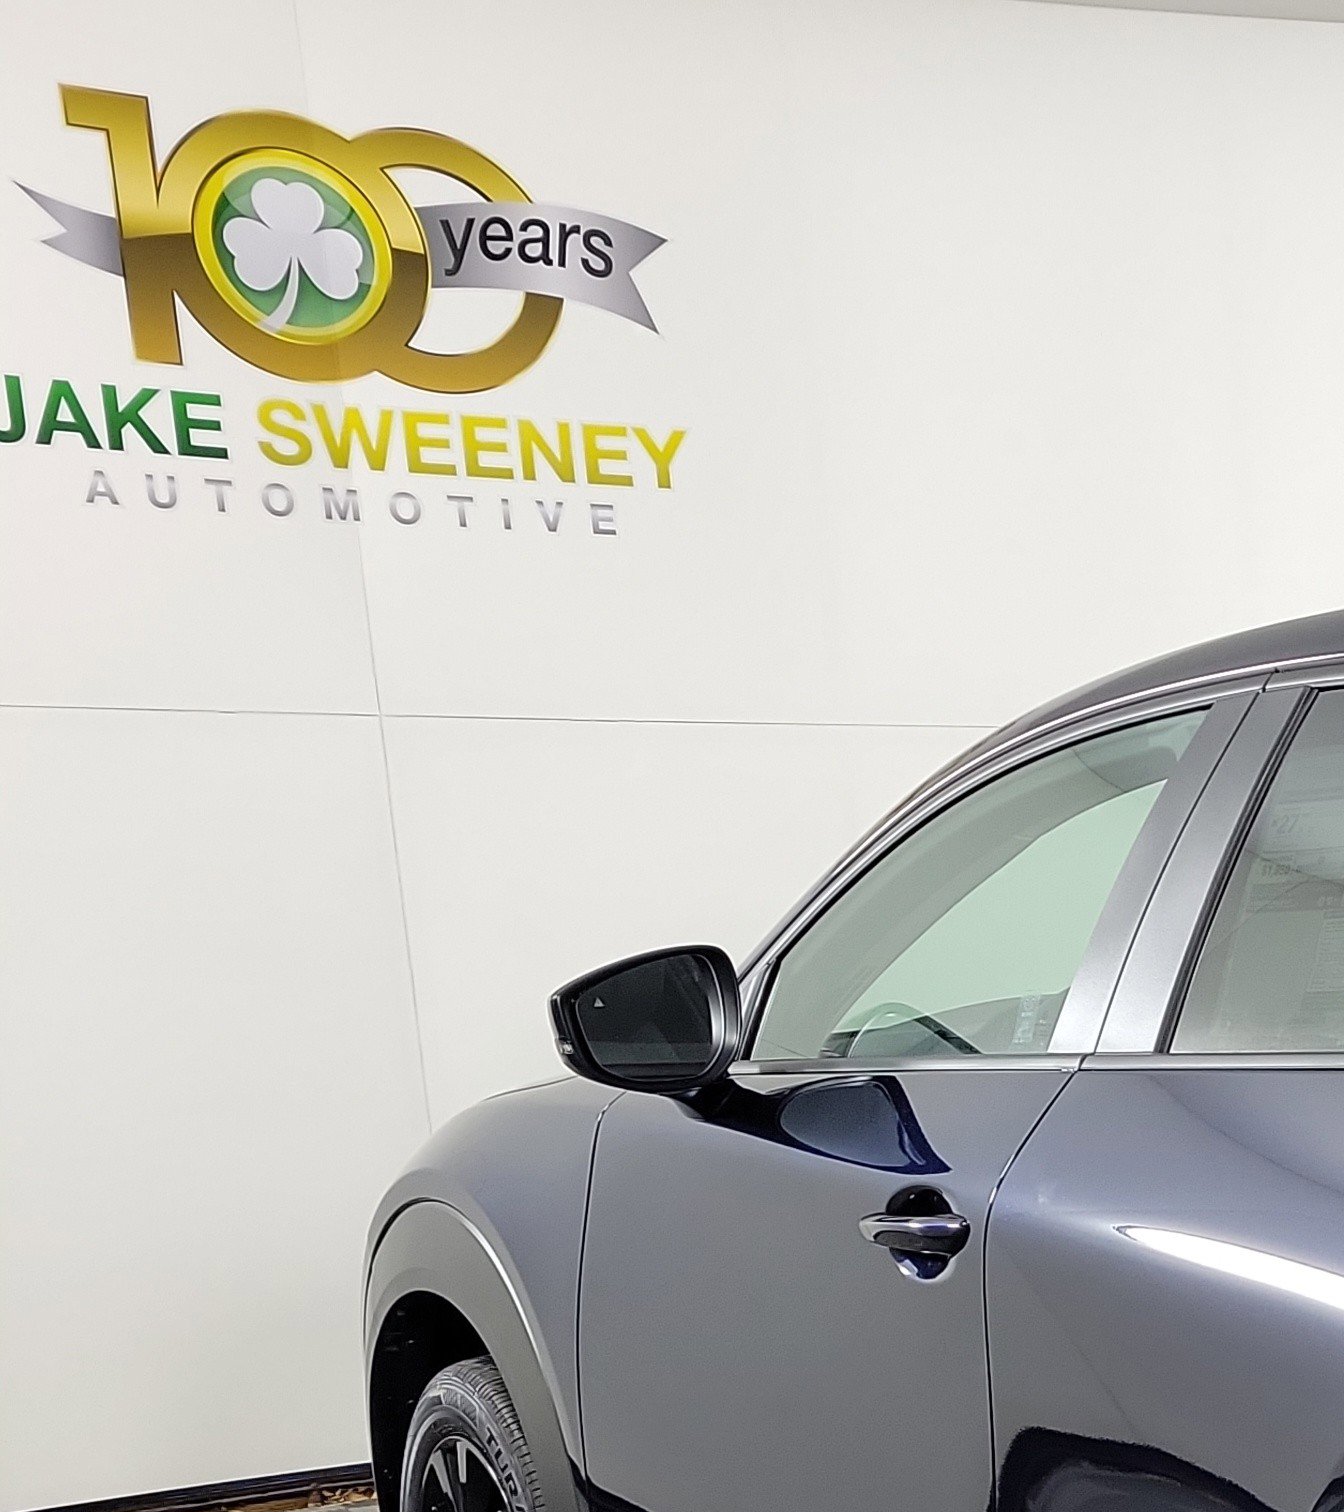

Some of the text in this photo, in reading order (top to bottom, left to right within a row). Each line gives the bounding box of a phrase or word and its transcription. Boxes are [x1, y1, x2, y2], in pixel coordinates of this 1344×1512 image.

[439, 214, 615, 279] years
[0, 373, 688, 491] JAKE SWEENEY
[84, 469, 619, 537] AUTOMOTIVE
